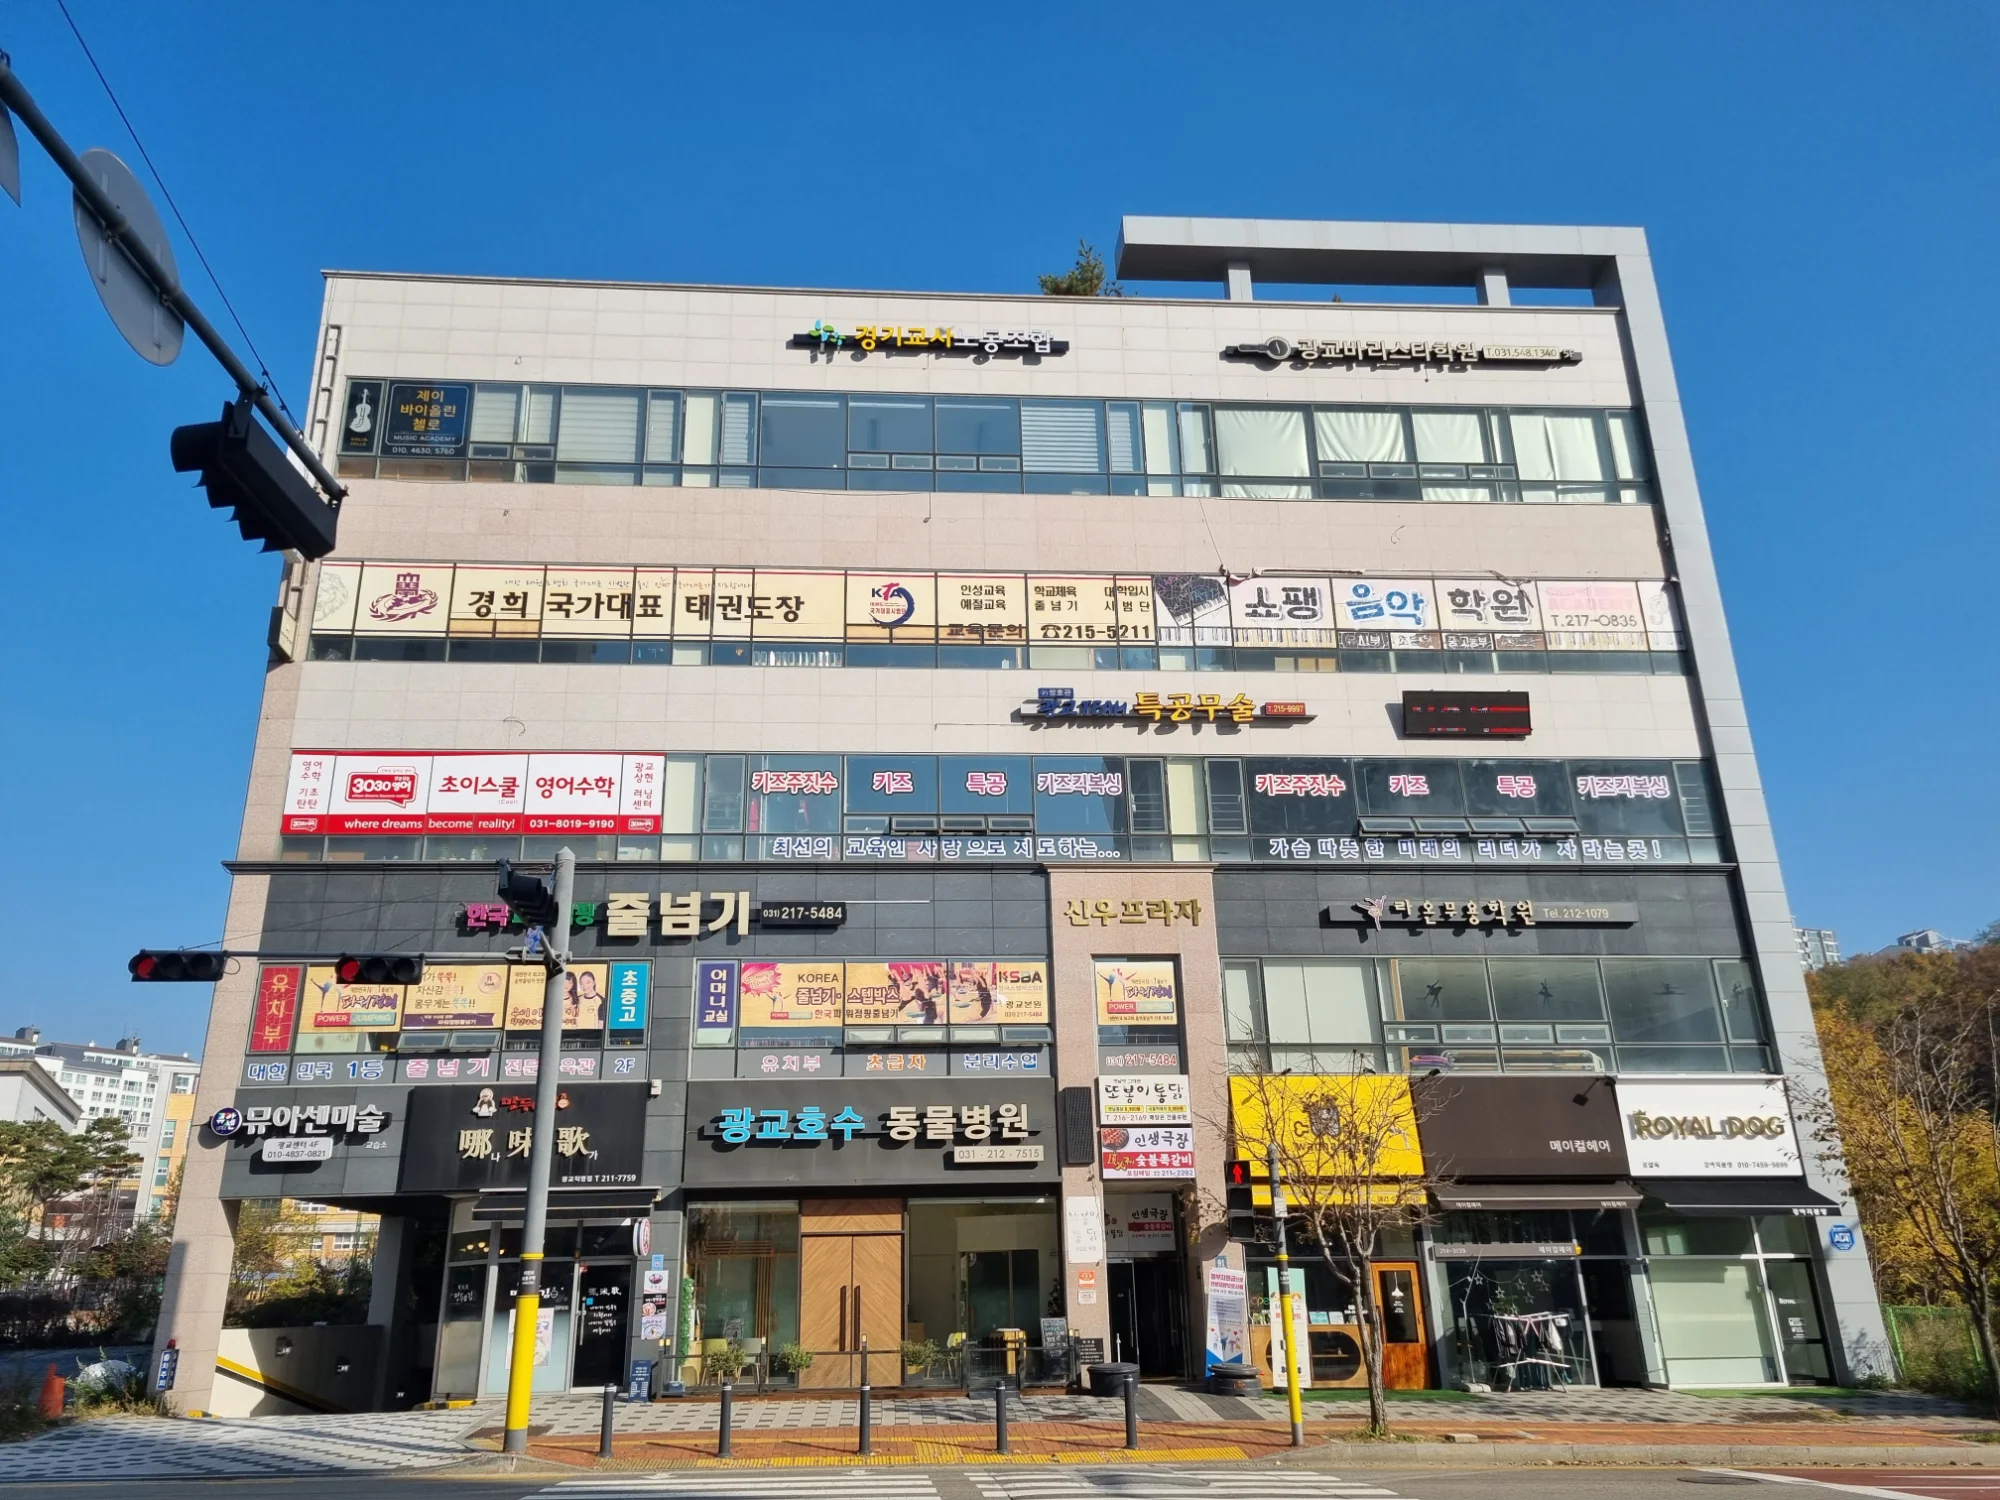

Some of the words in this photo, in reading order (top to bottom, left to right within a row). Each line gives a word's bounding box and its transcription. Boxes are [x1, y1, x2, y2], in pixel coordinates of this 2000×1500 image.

[1297, 338, 1478, 361] 광교바리스타학원
[416, 390, 444, 402] 제이
[400, 404, 457, 417] 바이올린
[412, 418, 440, 431] 첼로
[871, 583, 902, 600] KTA
[960, 585, 1006, 597] 인성교육
[1034, 585, 1077, 597] 학교체육
[1104, 585, 1149, 598] 대학입시
[468, 590, 529, 618] 경희
[545, 592, 664, 620] 국가대표
[685, 594, 805, 622] 태권도장
[960, 599, 1007, 611] 예절교육
[1034, 600, 1078, 612] 줄넘기
[1104, 600, 1150, 612] 시범단
[1245, 586, 1322, 622] 쇼팽
[1346, 582, 1426, 626] 음악
[1447, 588, 1533, 623] 학원
[1551, 614, 1638, 628] T.217-0835
[947, 623, 1023, 639] 교육문의
[1063, 624, 1150, 640] 215-5211
[1081, 700, 1128, 716] TEAM
[1133, 692, 1255, 722] 특공무술
[302, 760, 322, 771] 영어
[635, 762, 654, 772] 광교
[300, 771, 321, 781] 수학
[634, 773, 653, 783] 상현
[438, 775, 520, 798] 초이스쿨
[536, 776, 615, 799] 영어수학
[752, 771, 838, 795] 키즈주짓수
[873, 772, 913, 795] 키즈
[966, 772, 1007, 796] 특공
[1037, 773, 1122, 796] 키즈킥복싱
[1256, 774, 1345, 796] 키즈주짓수
[1390, 775, 1429, 796] 키즈
[1496, 776, 1536, 798] 특공
[1577, 776, 1671, 798] 키즈킥복싱
[299, 787, 318, 797] 기초
[633, 789, 653, 799] 러닝
[297, 799, 317, 809] 탄탄
[632, 800, 652, 810] 센터
[344, 818, 380, 829] where
[381, 818, 423, 829] dreams
[428, 818, 473, 829] become
[478, 818, 515, 829] reality!
[529, 819, 614, 829] 031-8019-9190
[773, 837, 832, 859] 최선의
[846, 838, 906, 859] 교육인
[1269, 838, 1311, 859] 가슴
[1317, 838, 1384, 859] 따뜻한
[1398, 838, 1461, 860] 미래의
[1478, 839, 1541, 860] 리더가
[465, 903, 509, 928] 한국
[606, 891, 749, 936] 줄넘기
[1063, 898, 1201, 926] 신우프라자
[1394, 899, 1536, 926] 라온무용학원
[1563, 908, 1610, 919] 212-1079
[797, 973, 839, 983] KOREA
[999, 970, 1042, 983] KSBA
[416, 986, 443, 995] 자신감
[709, 969, 727, 1008] 어머니
[619, 970, 638, 1022] 초중고
[847, 987, 900, 1006] 스텝박스
[264, 974, 288, 1044] 유치부
[1006, 1001, 1042, 1009] 광교본원
[317, 1013, 347, 1023] POWER
[703, 1010, 728, 1023] 교실
[815, 1009, 832, 1019] 한국
[406, 1058, 490, 1079] 줄넘기
[614, 1057, 635, 1074] 2F
[761, 1055, 821, 1071] 유치부
[866, 1055, 926, 1071] 초급자
[964, 1054, 1038, 1070] 분리수업
[347, 1060, 383, 1079] 1등
[242, 1104, 385, 1135] 뮤아센미술
[719, 1106, 865, 1143] 광교호수
[886, 1104, 1029, 1140] 동물병원
[1635, 1116, 1721, 1137] ROYAL
[1726, 1116, 1786, 1137] DOG
[277, 1141, 308, 1149] 광교센터
[365, 1141, 387, 1149] 교습소
[1134, 1130, 1189, 1149] 인생극장
[1549, 1140, 1611, 1153] 메이컬헤어
[267, 1151, 326, 1159] 010-4837-0821
[491, 1152, 501, 1162] 나
[589, 1151, 598, 1161] 가
[1135, 1153, 1192, 1168] 숯불쪽갈비
[1131, 1208, 1169, 1221] 인생극장
[1833, 1232, 1851, 1242] ADT
[1538, 1246, 1573, 1254] 메이컬헤어
